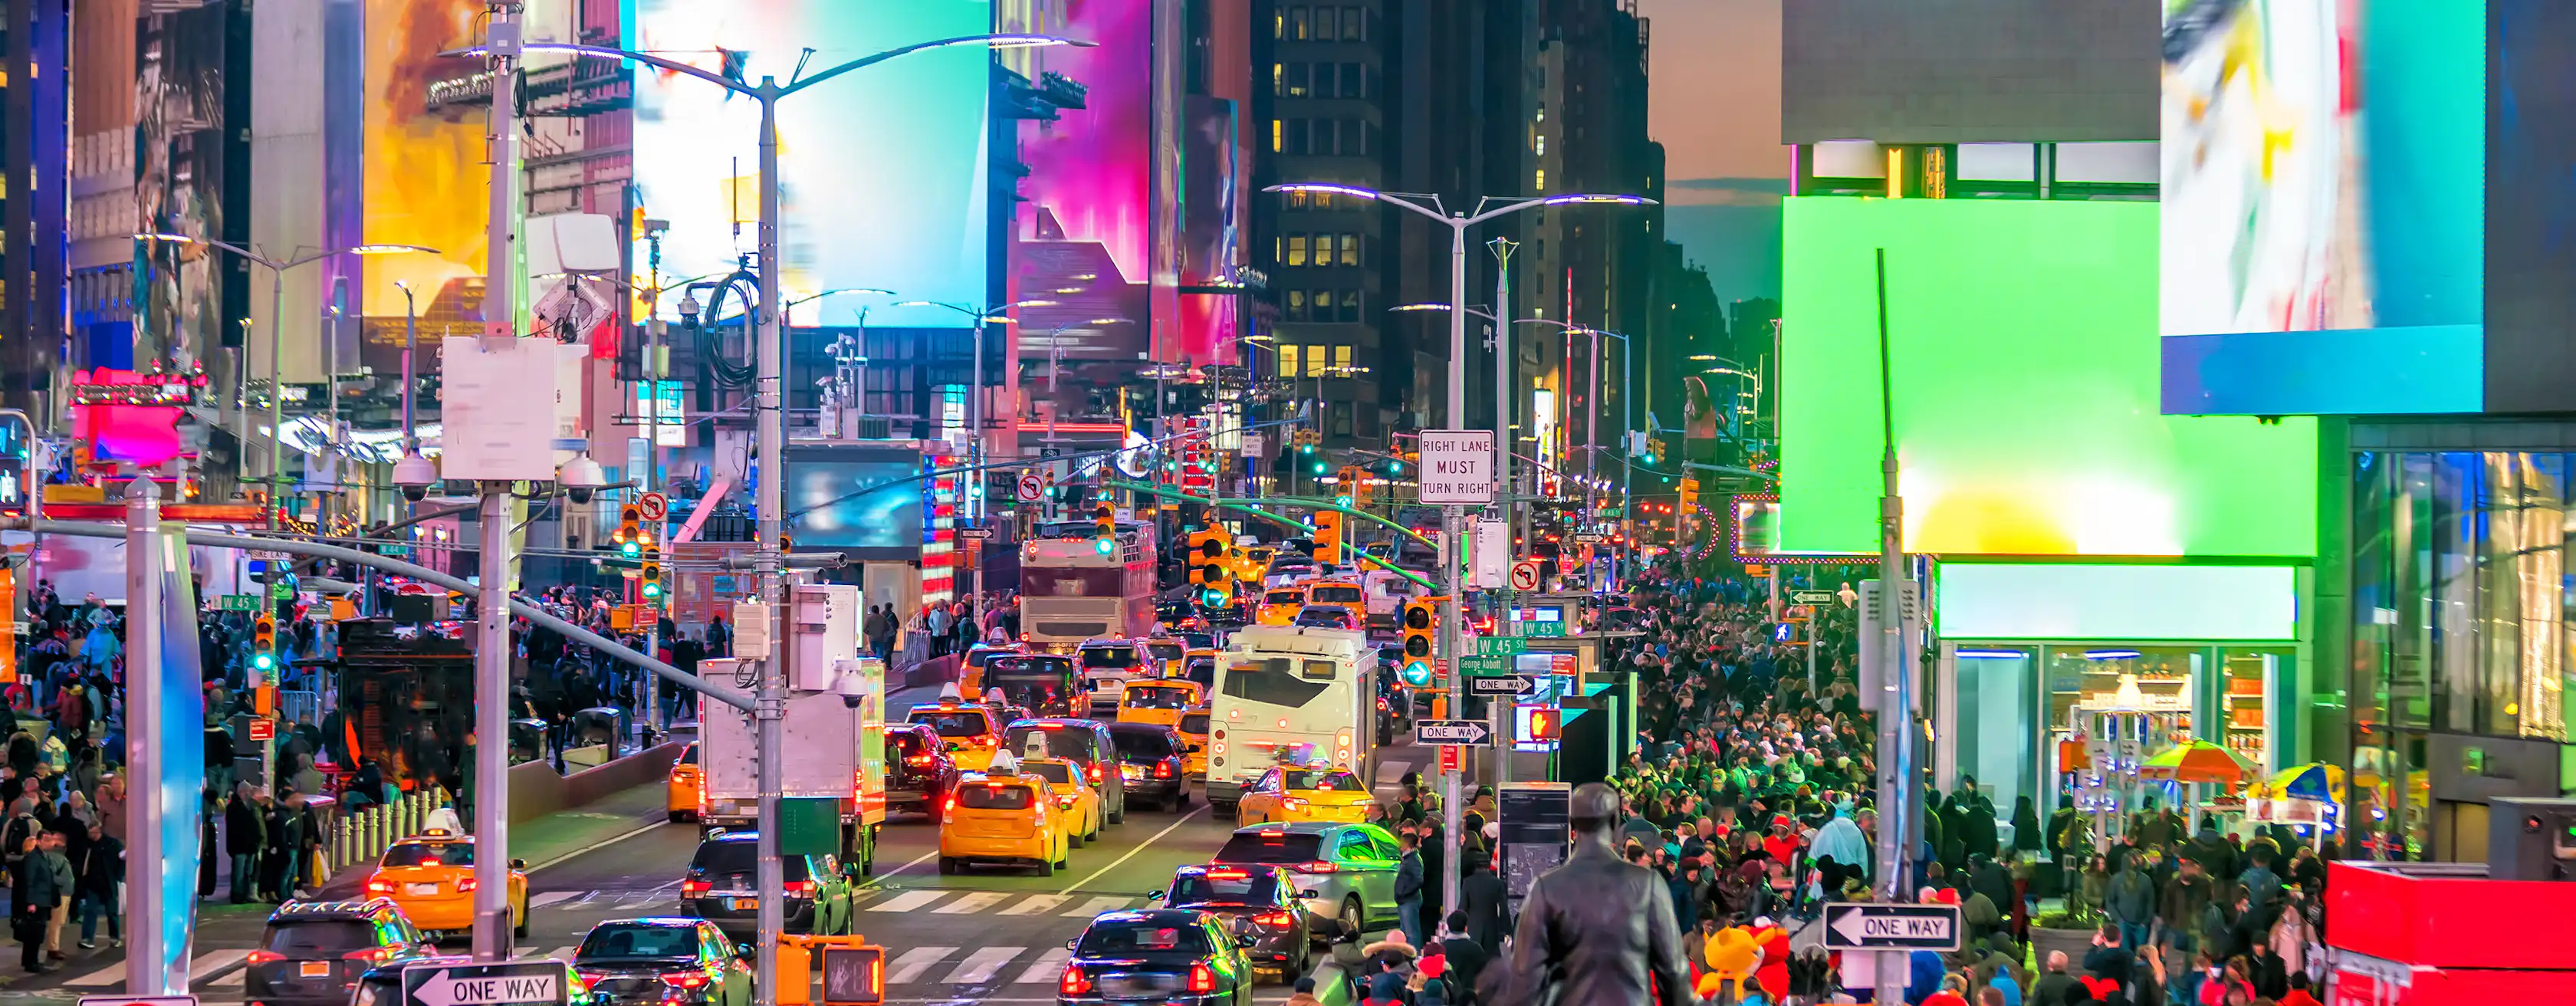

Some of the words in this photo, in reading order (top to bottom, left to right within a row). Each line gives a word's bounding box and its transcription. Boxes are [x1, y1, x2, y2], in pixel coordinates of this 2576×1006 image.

[1423, 441, 1455, 452] RIGHT
[1461, 441, 1490, 452] LANE
[1438, 461, 1475, 474] MUST
[1423, 483, 1451, 494] TURN
[1458, 483, 1490, 494] RIGHT
[224, 597, 233, 608] W
[238, 597, 249, 609] 45
[1526, 623, 1534, 634] W
[1539, 623, 1552, 635] 45
[1480, 640, 1491, 653] W
[1497, 640, 1510, 653] 45
[1516, 640, 1524, 649] St
[1460, 659, 1480, 671] George
[1482, 659, 1501, 669] Abbott
[1428, 728, 1447, 737] ONE
[1457, 728, 1479, 737] WAY
[1865, 919, 1901, 935] ONE
[1907, 919, 1944, 935] WAY
[454, 981, 498, 1001] ONE
[505, 978, 549, 999] WAY
